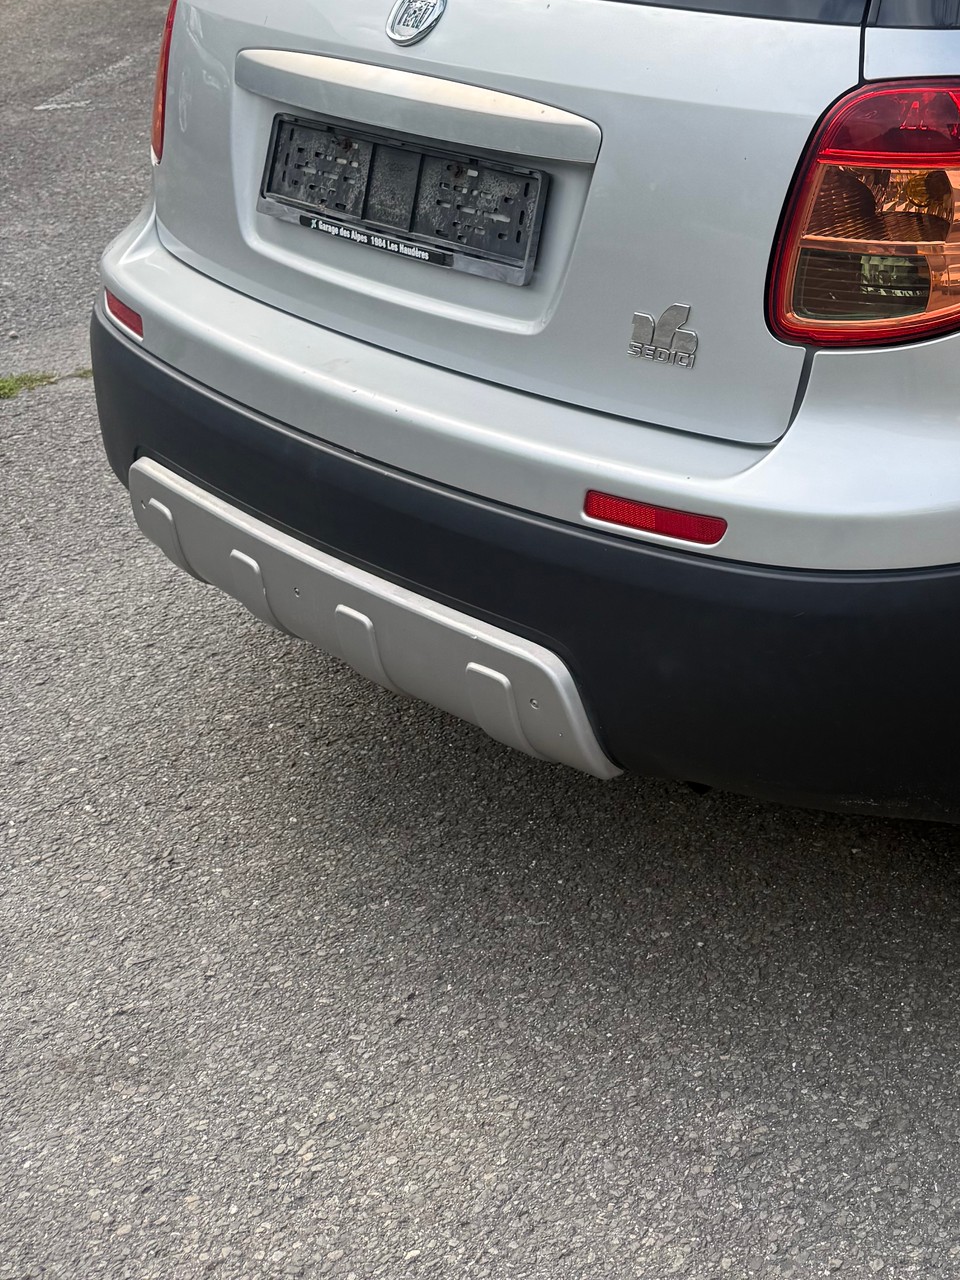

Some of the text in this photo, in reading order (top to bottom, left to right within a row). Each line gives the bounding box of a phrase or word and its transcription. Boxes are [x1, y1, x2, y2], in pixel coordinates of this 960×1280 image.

[318, 221, 430, 260] Garage des Alpes 1984 Les Haudères
[626, 341, 696, 369] SEDICI
